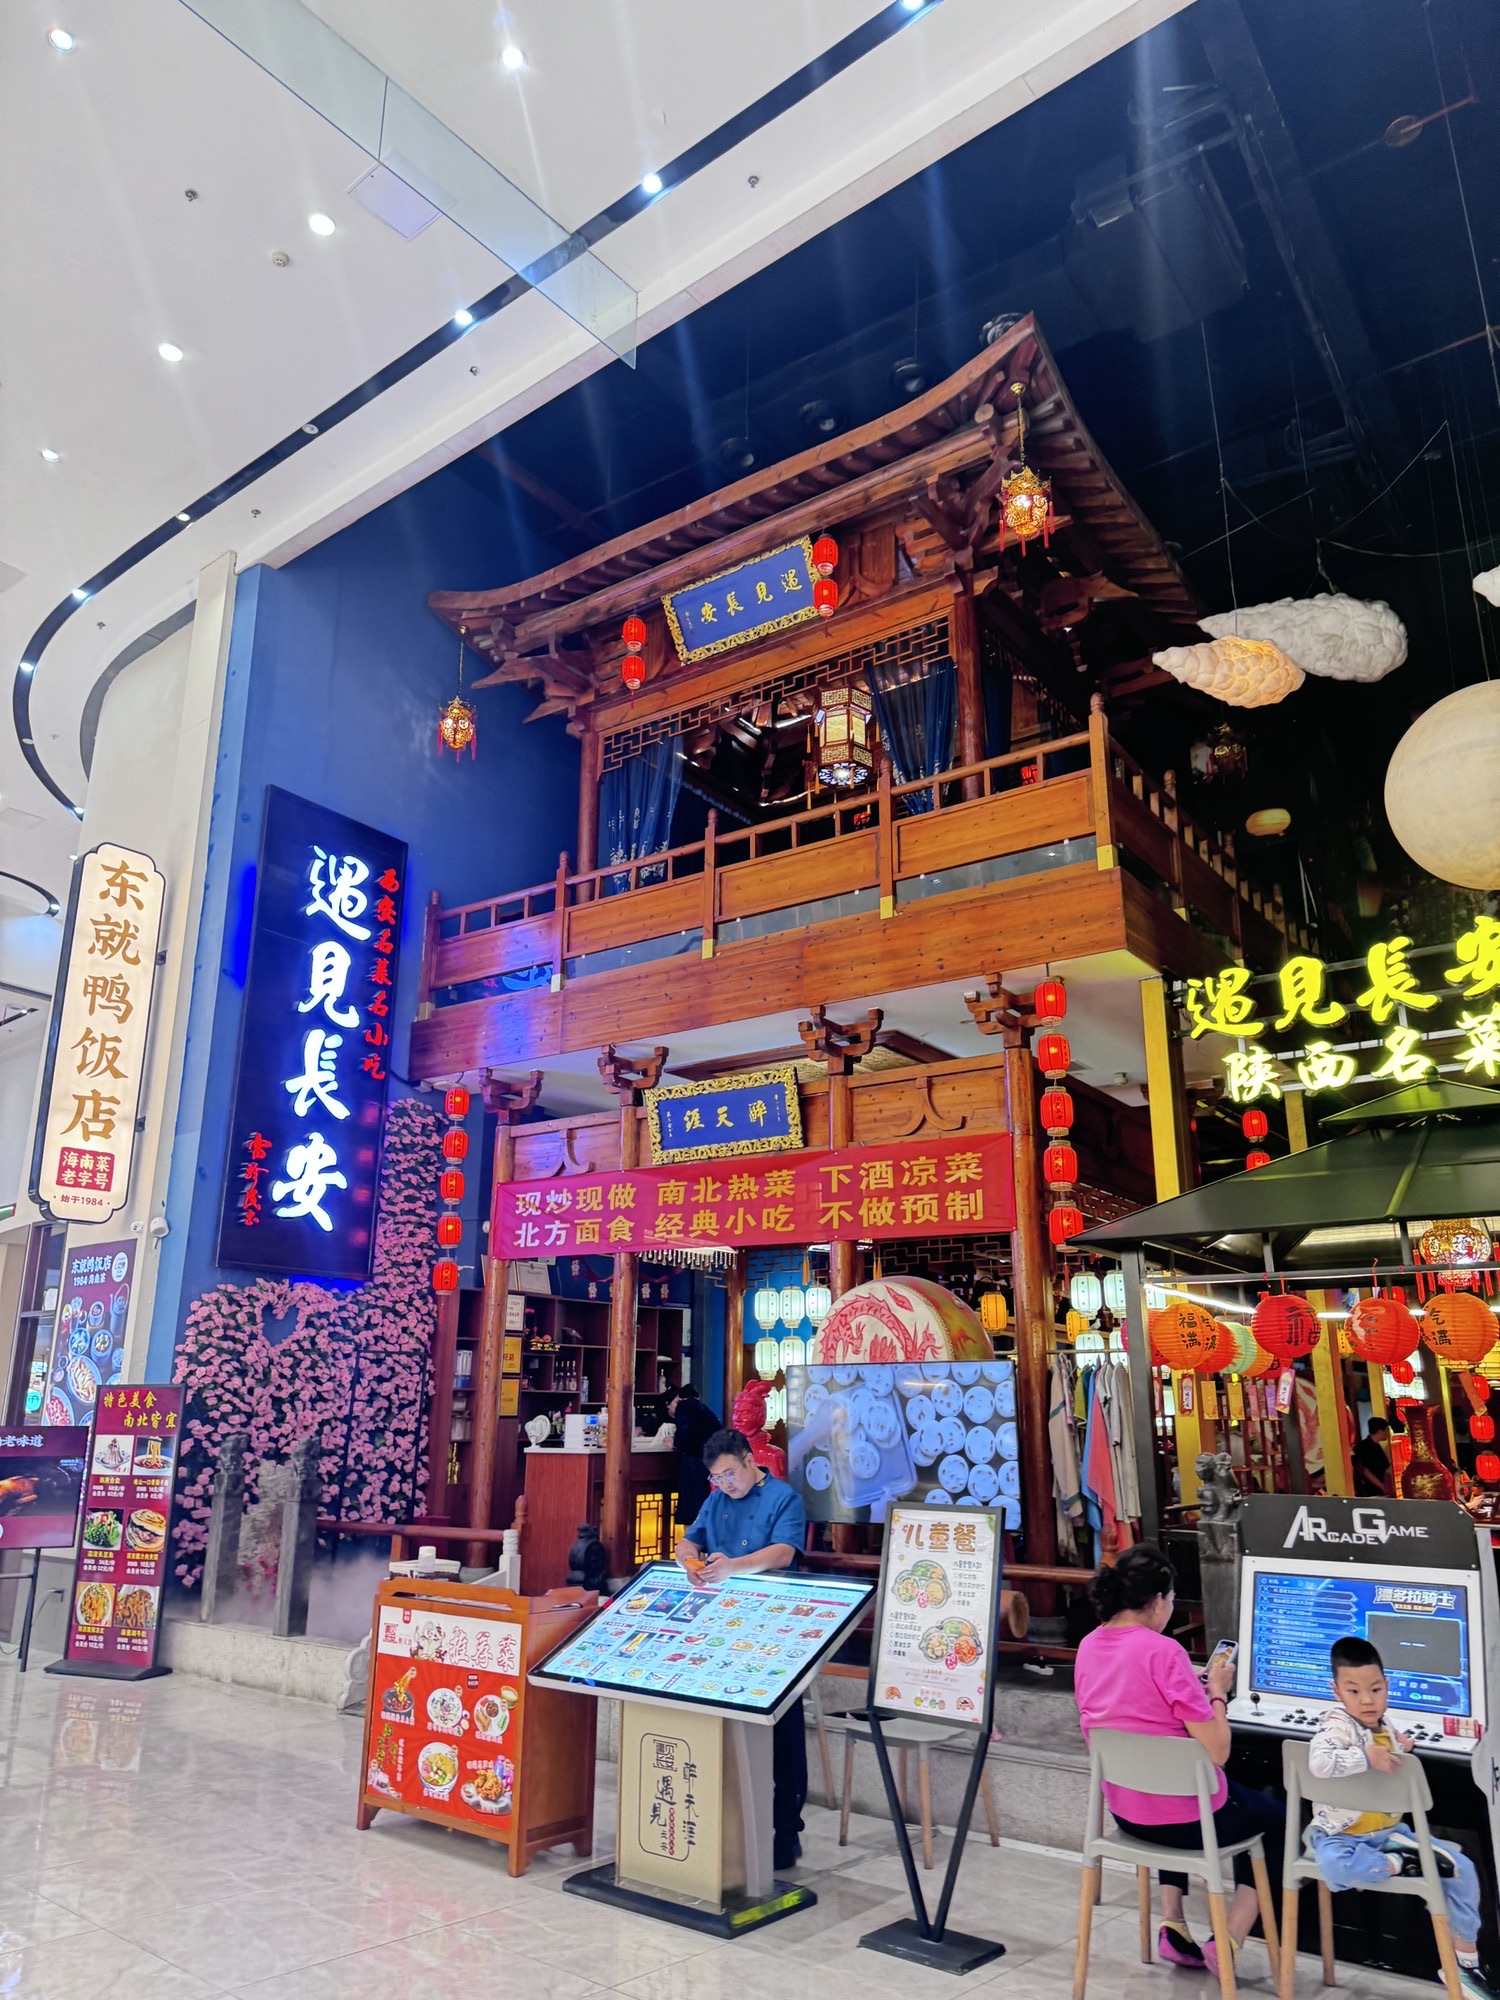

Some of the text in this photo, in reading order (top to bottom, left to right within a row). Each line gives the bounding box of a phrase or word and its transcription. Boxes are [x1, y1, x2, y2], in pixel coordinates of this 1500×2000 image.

[60, 859, 149, 1143] 东就鸭饭店
[62, 1151, 111, 1172] 海南菜
[61, 1168, 108, 1189] 老字号
[515, 1152, 984, 1217] 现炒现做 南北热菜 下酒凉菜
[61, 1194, 103, 1206] 始于1984
[513, 1189, 984, 1248] 北方面食 经典小吃 不做预制
[103, 1391, 157, 1409] 特色美食
[123, 1410, 178, 1429] 南北皆宜
[904, 1521, 976, 1552] 儿童餐
[1378, 1588, 1455, 1607] 潘多拉骑士
[449, 1626, 517, 1672] 推荐菜
